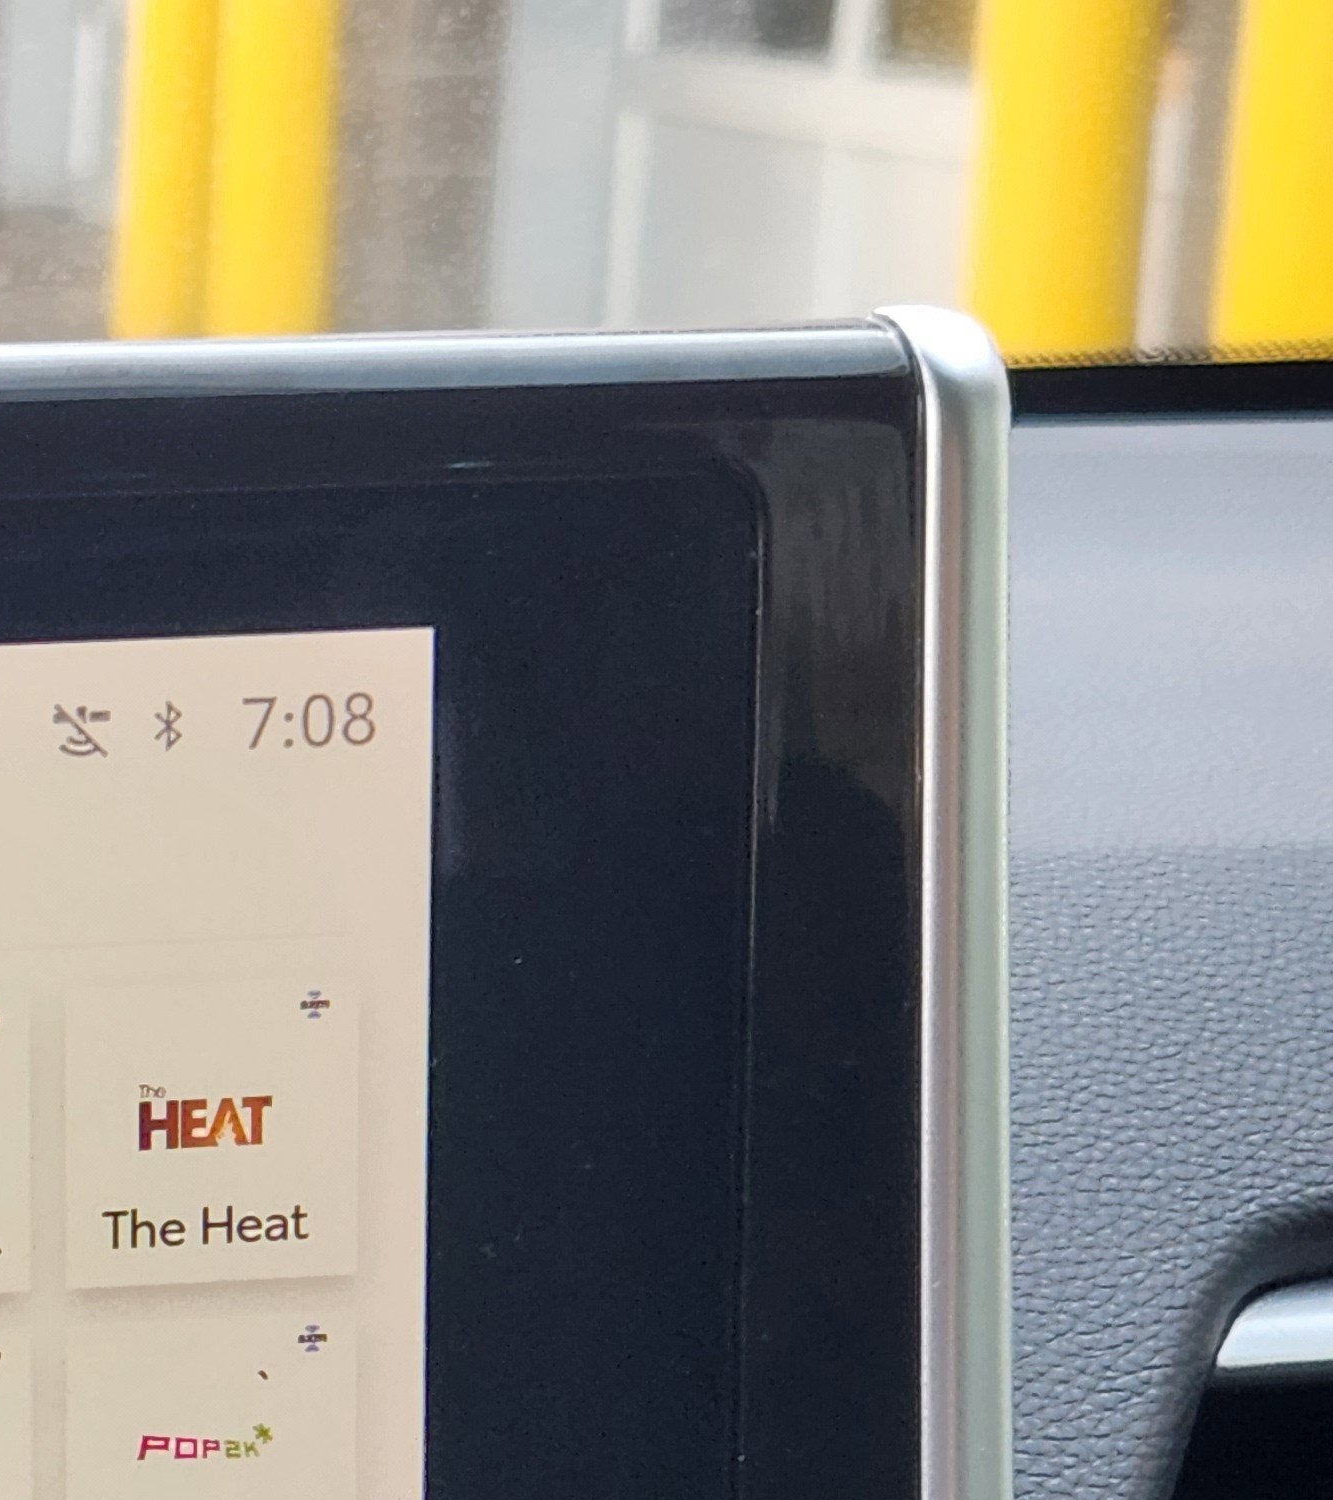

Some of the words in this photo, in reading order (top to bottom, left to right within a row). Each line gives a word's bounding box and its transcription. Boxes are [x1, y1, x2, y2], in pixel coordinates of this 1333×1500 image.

[242, 692, 377, 750] 7:08
[138, 1095, 273, 1152] HEAT
[101, 1208, 186, 1250] The
[202, 1204, 309, 1245] Heat
